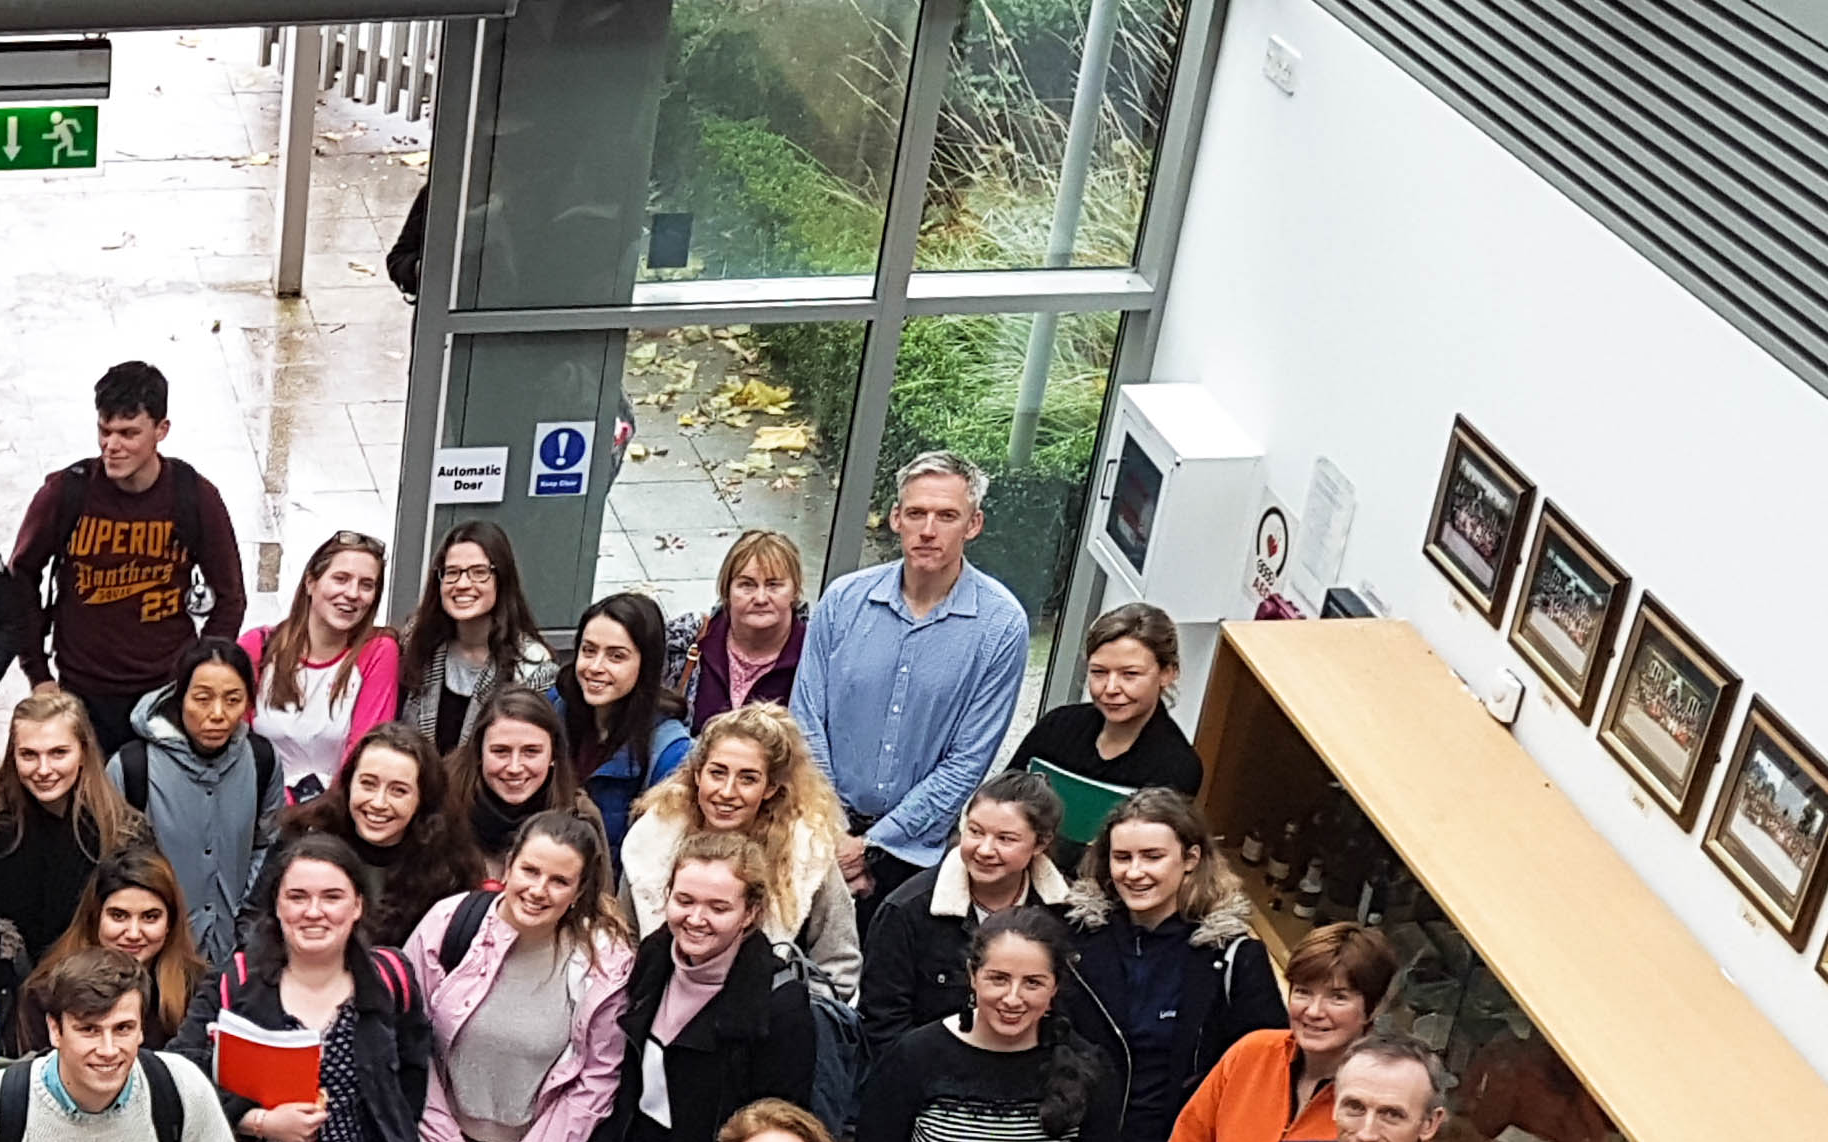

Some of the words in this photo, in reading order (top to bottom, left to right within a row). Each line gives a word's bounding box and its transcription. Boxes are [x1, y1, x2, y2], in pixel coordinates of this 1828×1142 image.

[438, 464, 501, 477] Automatic
[454, 480, 484, 490] Door
[74, 560, 174, 594] Panthers
[140, 588, 181, 623] 23
